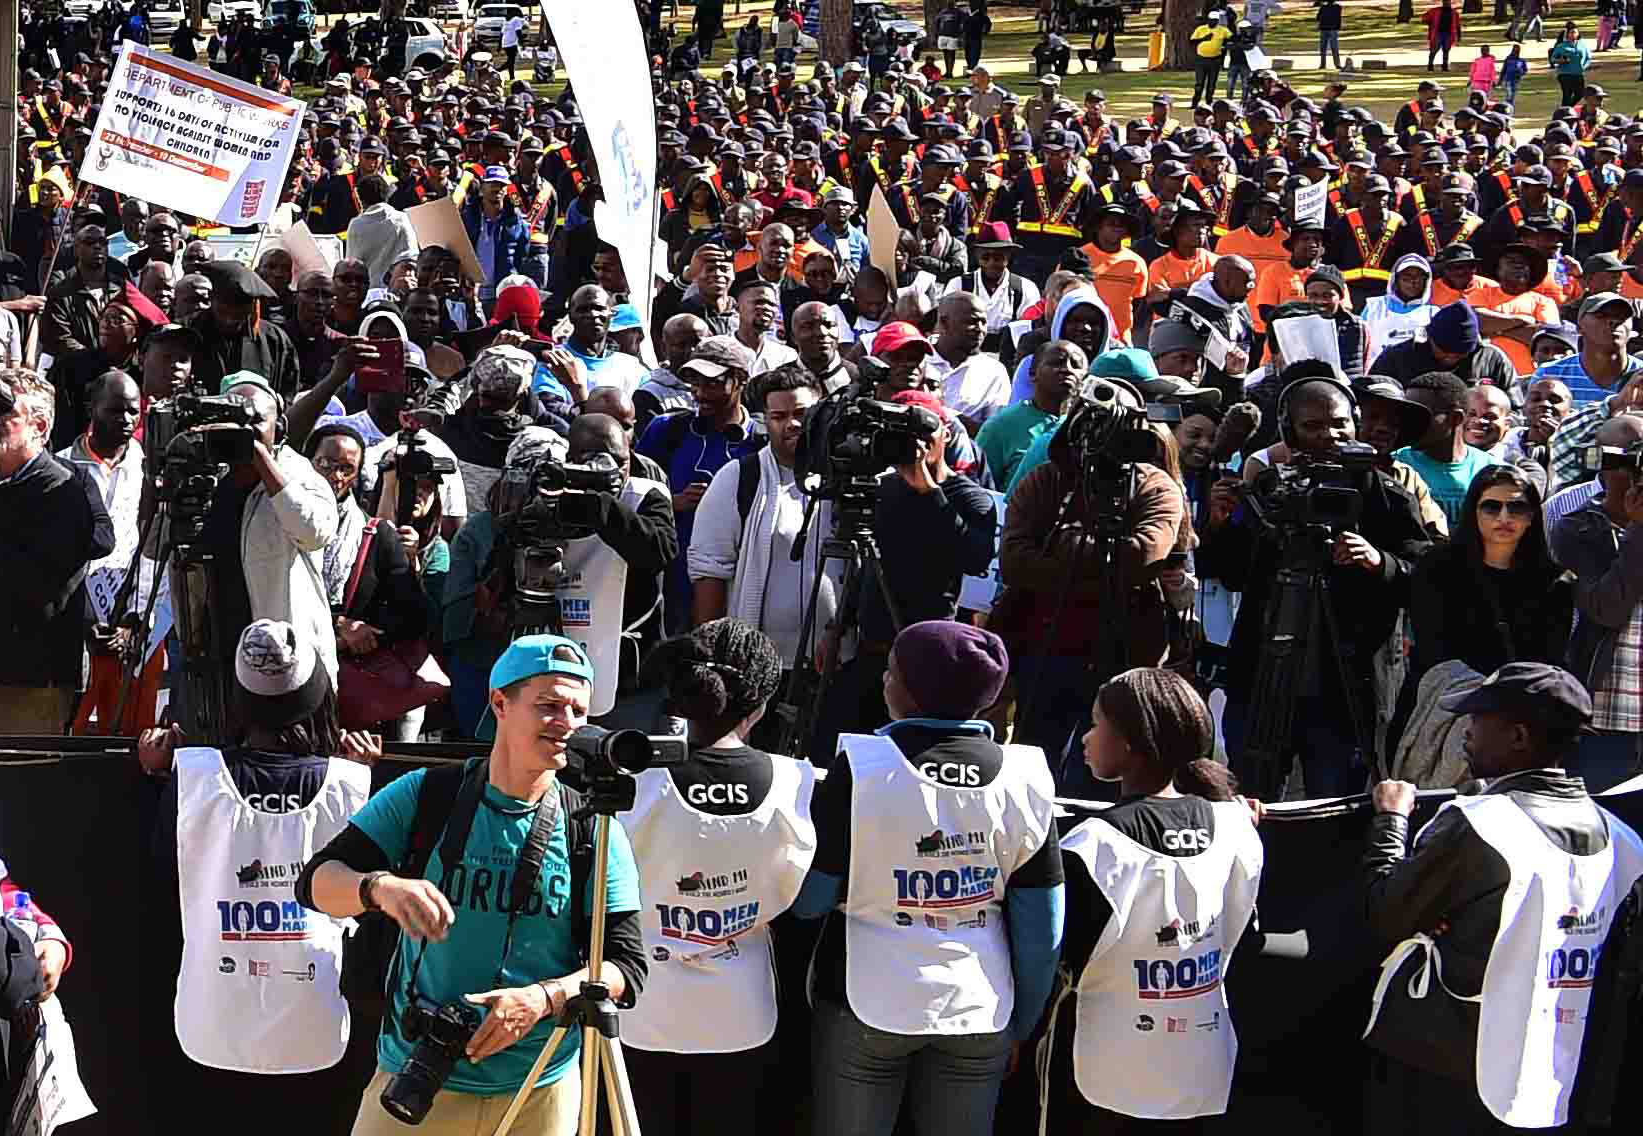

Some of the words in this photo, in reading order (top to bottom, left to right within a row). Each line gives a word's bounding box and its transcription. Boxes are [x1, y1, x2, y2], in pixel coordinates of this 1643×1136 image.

[123, 67, 195, 102] DEPARTMENT
[115, 88, 164, 114] SUPPORTS
[178, 111, 200, 126] DAYS
[201, 117, 214, 129] OF
[215, 123, 259, 145] ACTIVISM
[259, 136, 280, 149] FOR
[115, 104, 129, 116] NO
[131, 108, 175, 133] VIOLENCE
[176, 126, 212, 146] AGAINST
[214, 137, 248, 157] WOMEN
[250, 149, 272, 162] AND
[166, 137, 211, 160] CHILDREN
[919, 762, 980, 786] GCIS
[244, 793, 301, 813] GCIS
[688, 784, 749, 805] GCIS
[893, 868, 960, 900] 100
[959, 866, 999, 886] MEN
[959, 880, 995, 897] MARCH
[217, 900, 281, 932] 100
[656, 902, 722, 938] 100
[722, 901, 760, 924] MEN
[722, 916, 757, 937] MARCH
[1134, 957, 1197, 991] 100
